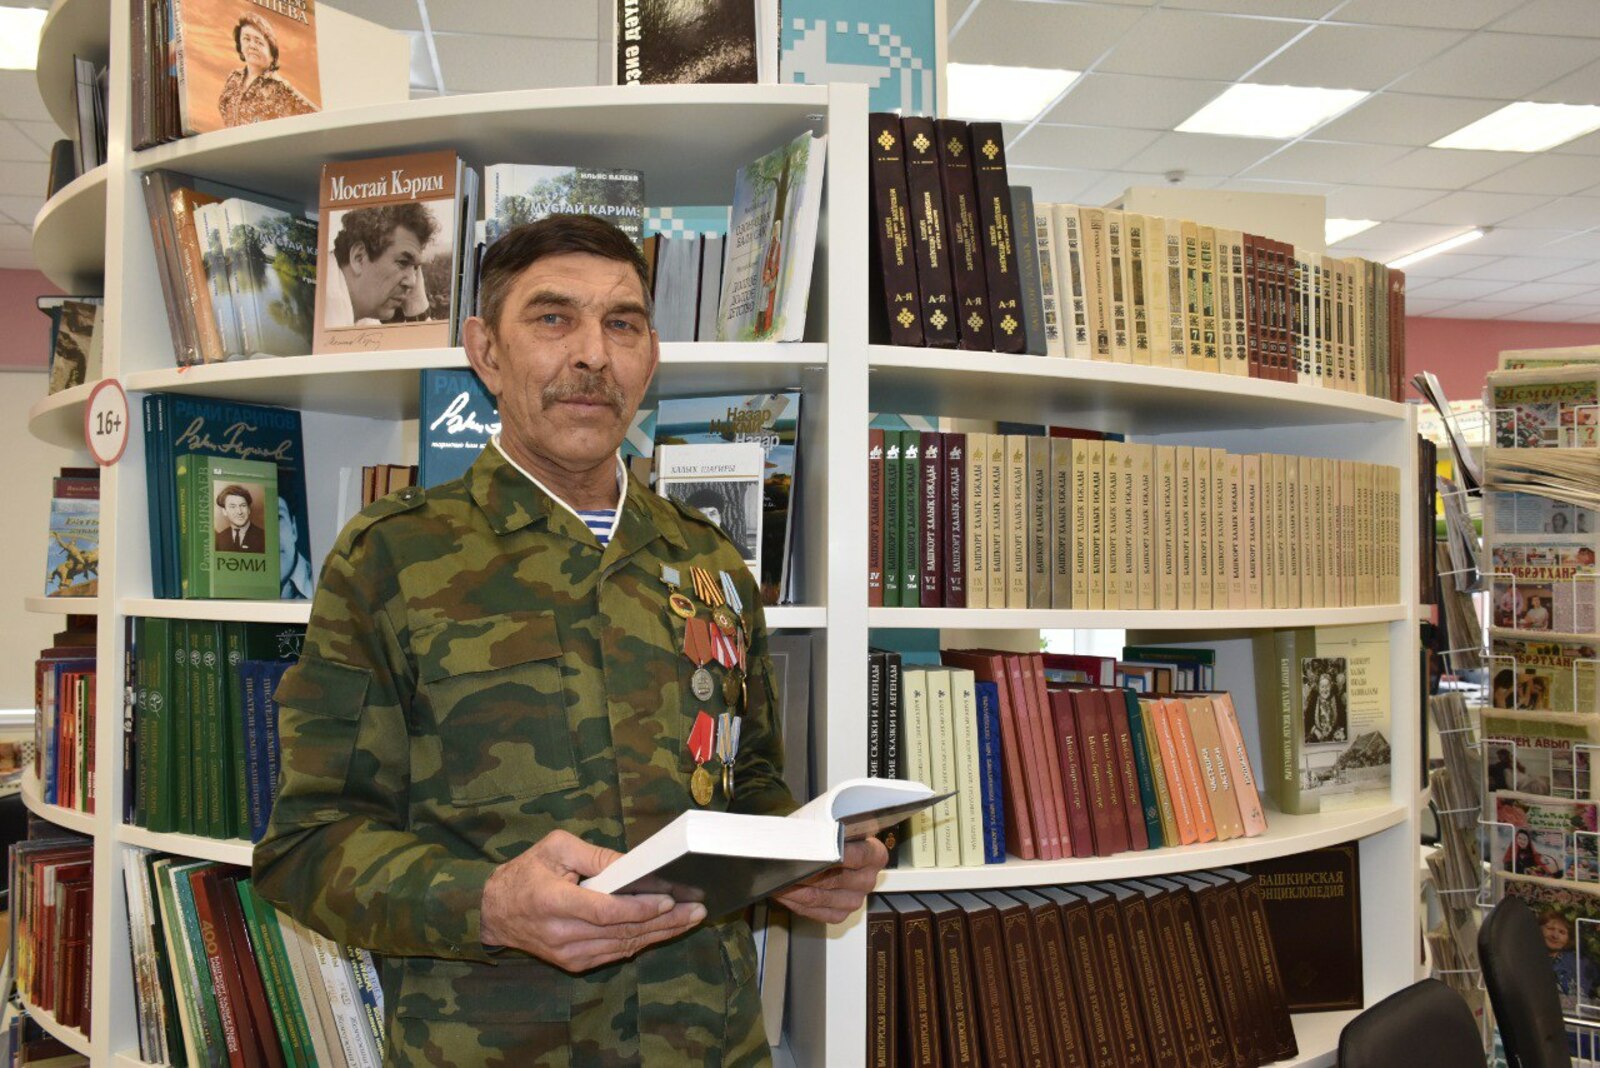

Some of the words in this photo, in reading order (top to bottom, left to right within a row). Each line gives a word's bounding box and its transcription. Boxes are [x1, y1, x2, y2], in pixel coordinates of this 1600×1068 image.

[330, 176, 386, 202] Мостай
[390, 170, 444, 198] Кәрим
[96, 410, 122, 435] 16+
[198, 466, 209, 533] БИКБАЕВ
[216, 557, 266, 573] РӘМИ
[871, 664, 880, 707] ЛЕГЕНДЫ
[888, 664, 897, 707] ЛЕГЕНДЫ
[871, 709, 879, 717] И
[888, 709, 896, 717] И
[871, 720, 879, 757] СКАЗКИ
[888, 720, 896, 757] СКАЗКИ
[1259, 871, 1343, 886] БАШКИРСКАЯ
[1259, 885, 1344, 900] ЭНЦИКЛОПЕДИЯ
[203, 920, 218, 954] 400
